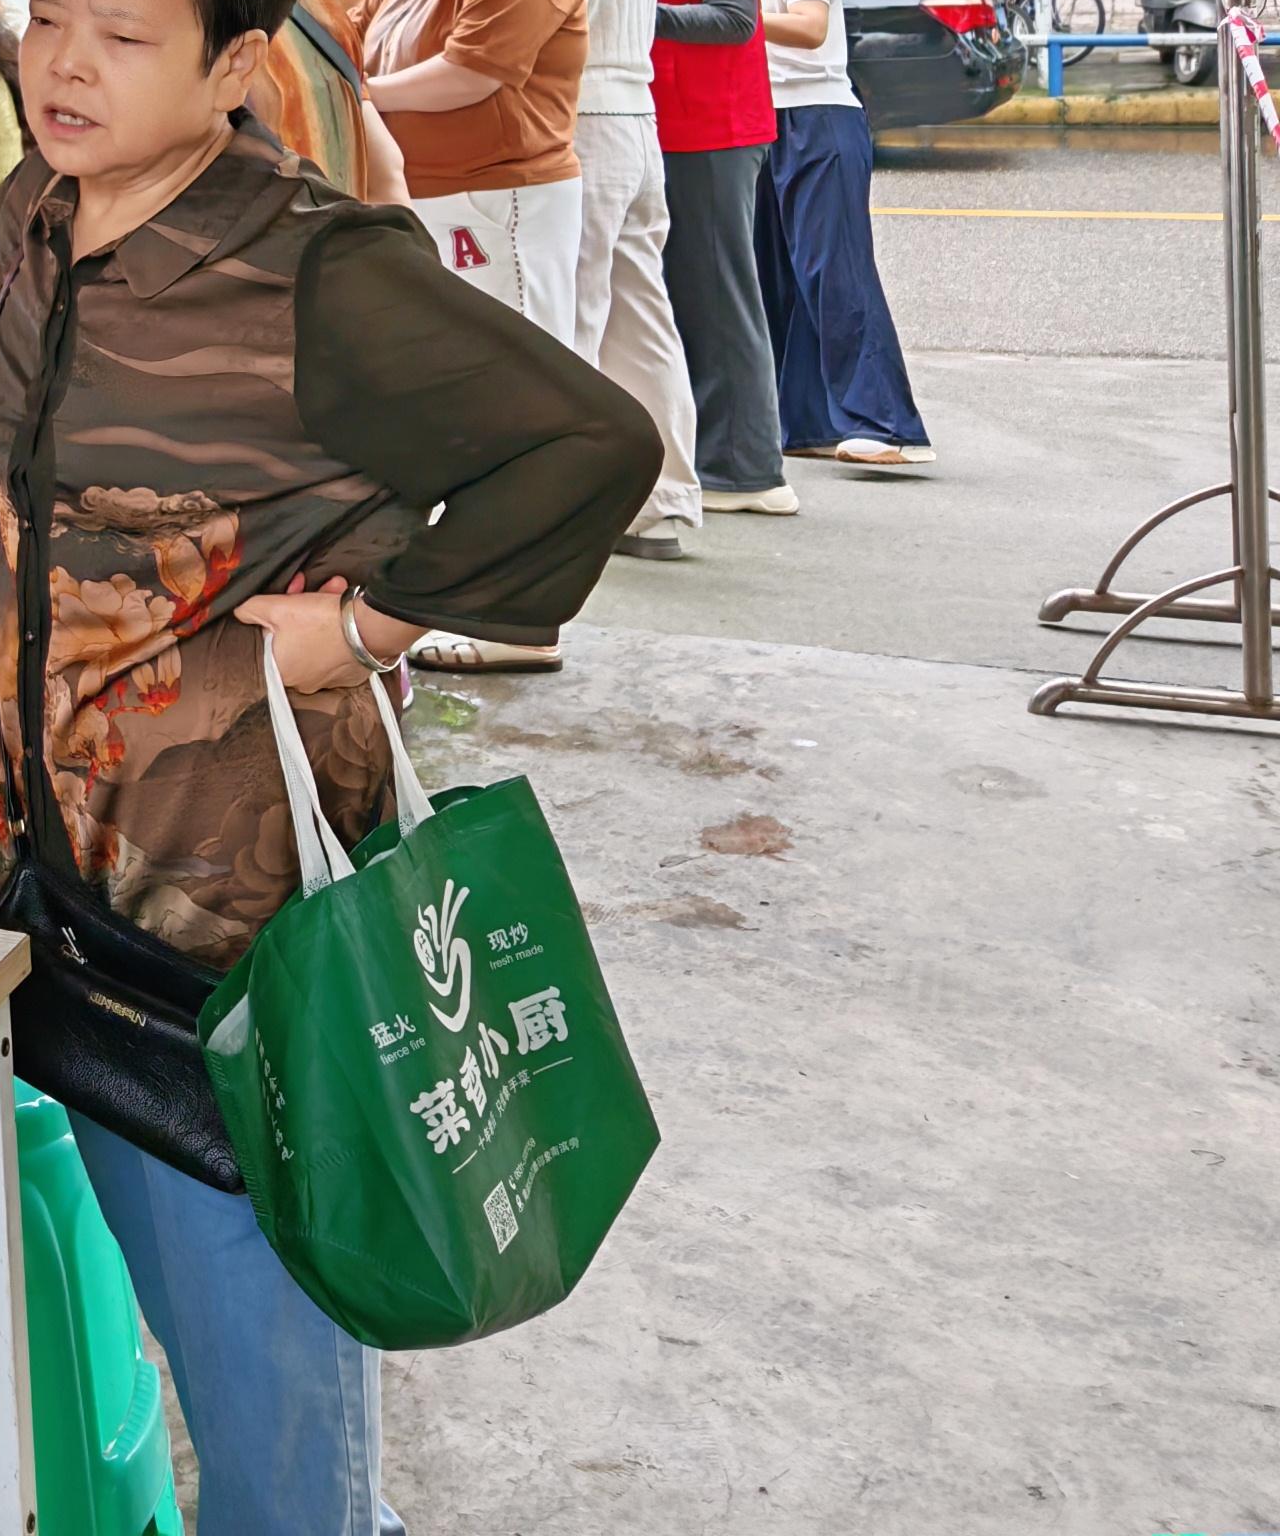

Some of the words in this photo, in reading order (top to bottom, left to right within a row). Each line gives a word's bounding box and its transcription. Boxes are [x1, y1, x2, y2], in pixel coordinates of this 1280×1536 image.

[449, 226, 491, 271] A
[486, 921, 529, 953] 现炒
[488, 954, 515, 971] fresh
[515, 943, 544, 961] made
[368, 1013, 417, 1049] 猛火
[380, 1043, 410, 1065] fierce
[410, 1036, 426, 1053] fire
